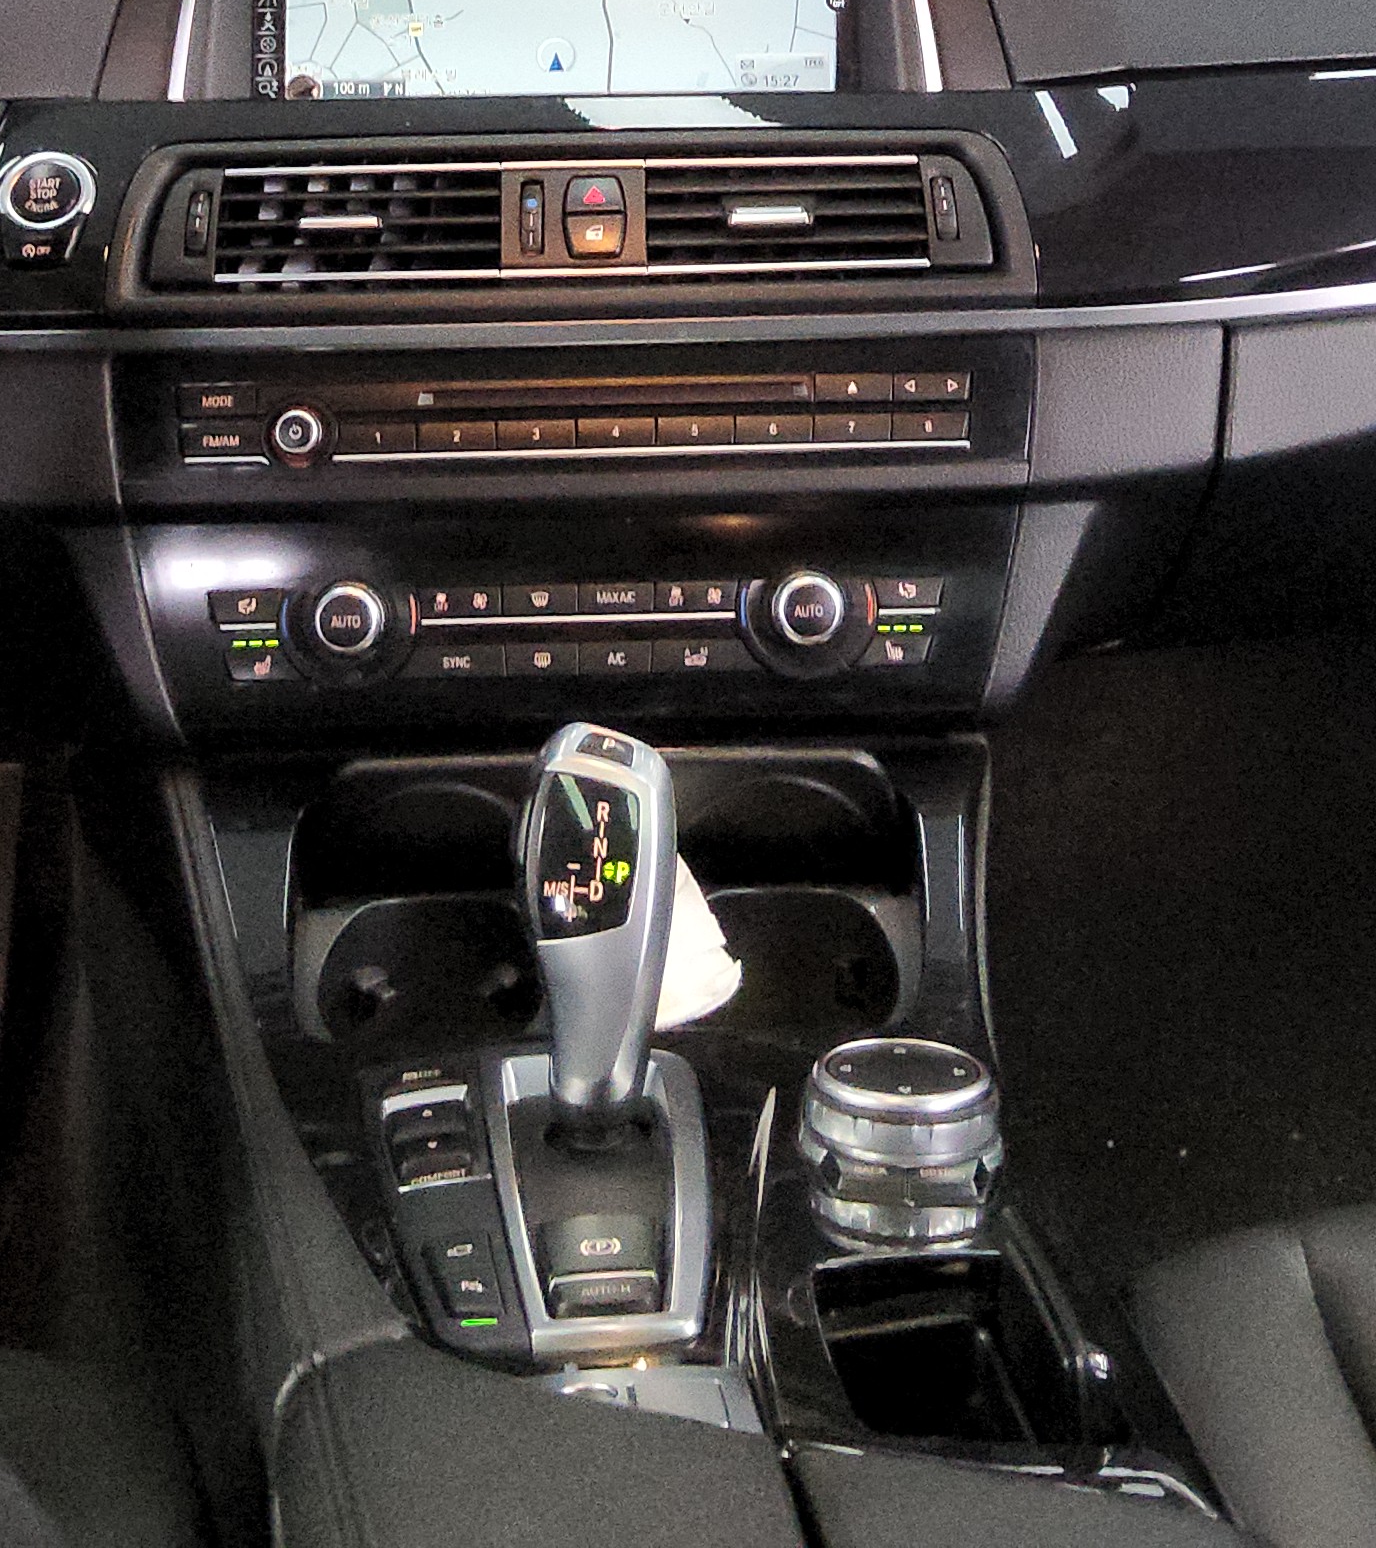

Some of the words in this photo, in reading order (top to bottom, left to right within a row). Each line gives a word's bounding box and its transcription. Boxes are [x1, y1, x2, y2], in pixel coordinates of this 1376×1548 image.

[333, 82, 355, 95] 100
[763, 74, 800, 88] 15:27
[28, 177, 62, 190] START
[29, 188, 58, 200] STOP
[201, 394, 235, 409] MODE
[201, 435, 241, 449] FM/AM
[794, 603, 824, 619] AUTO
[330, 614, 361, 630] AUTO
[442, 655, 471, 669] SYNC
[607, 651, 627, 666] A/C
[602, 737, 616, 750] P
[596, 800, 610, 823] R
[593, 836, 609, 859] N
[616, 860, 631, 884] P
[543, 880, 570, 897] M/S
[589, 879, 604, 902] D
